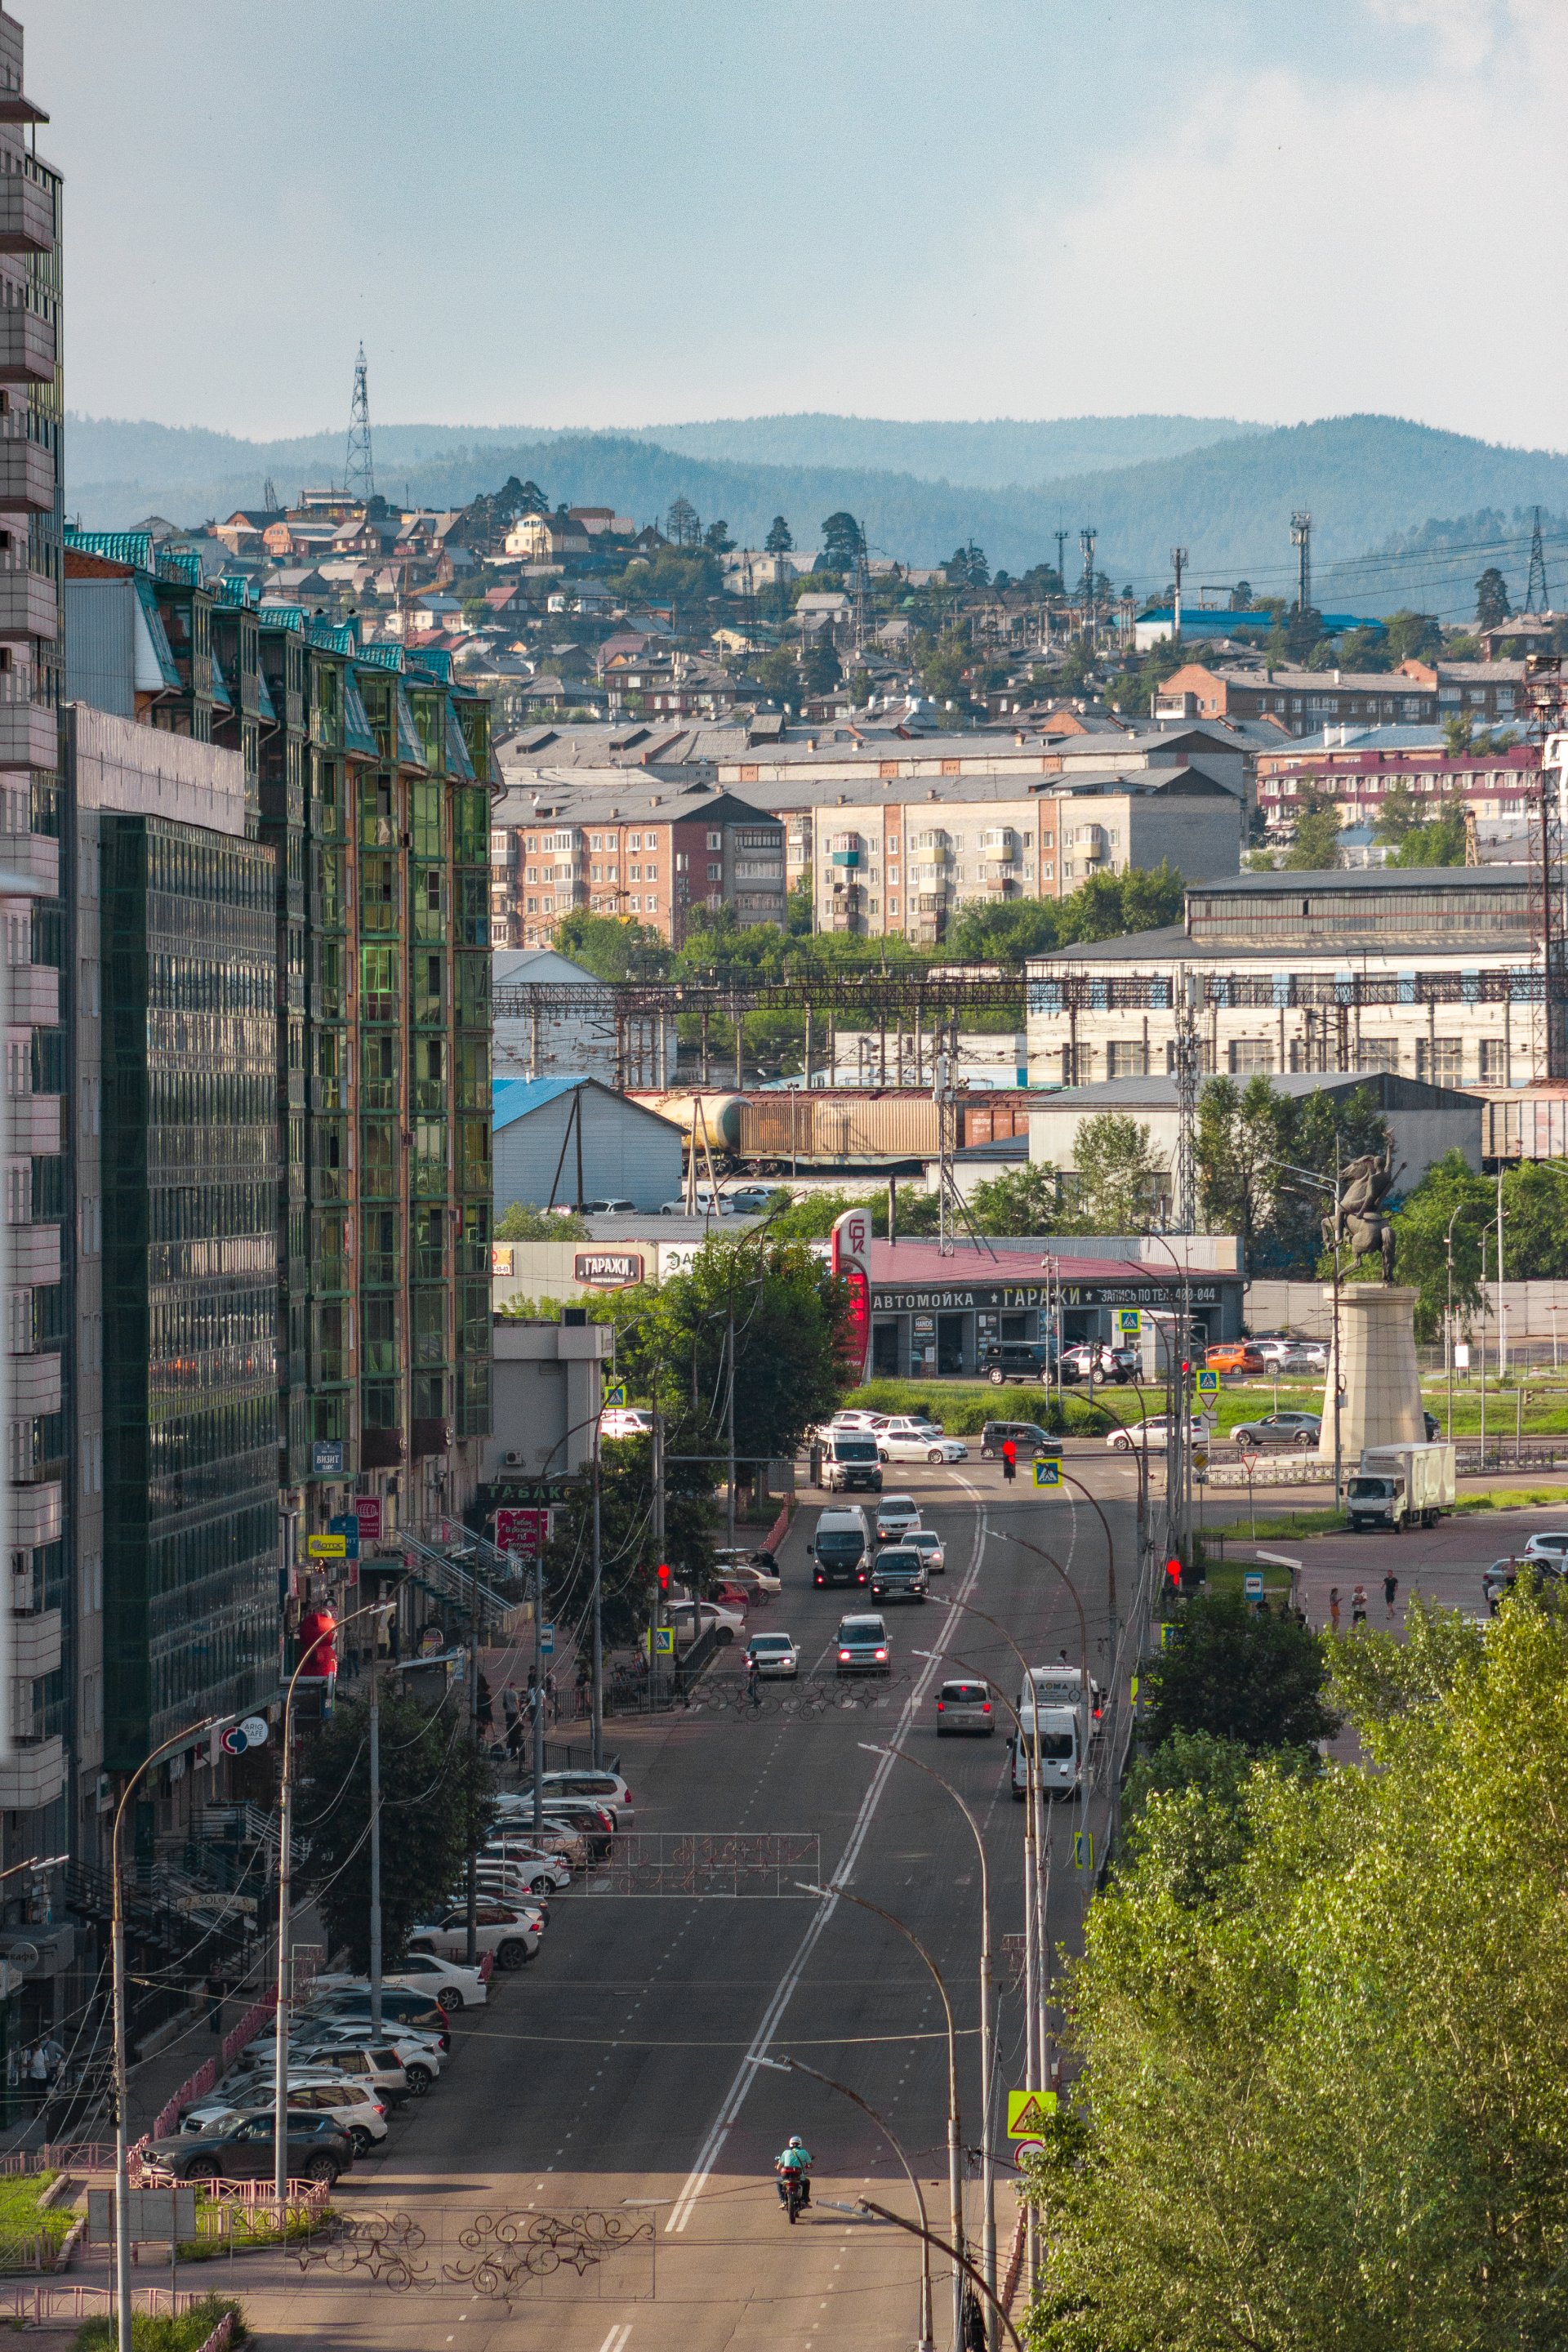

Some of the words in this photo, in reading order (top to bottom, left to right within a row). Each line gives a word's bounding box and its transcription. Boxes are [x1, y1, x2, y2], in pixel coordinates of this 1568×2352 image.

[585, 1258, 630, 1276] ГАРАЖИ
[873, 1292, 974, 1309] АВТОМОЙКА
[1003, 1287, 1080, 1307] ГАРАЖИ
[1101, 1289, 1137, 1303] ЗАПИСЬ
[1138, 1289, 1151, 1301] ПО
[1175, 1288, 1215, 1301] 400-044
[316, 1454, 340, 1464] ВИЗИТ
[487, 1485, 561, 1499] ТАБАК
[198, 1895, 227, 1904] SOLO
